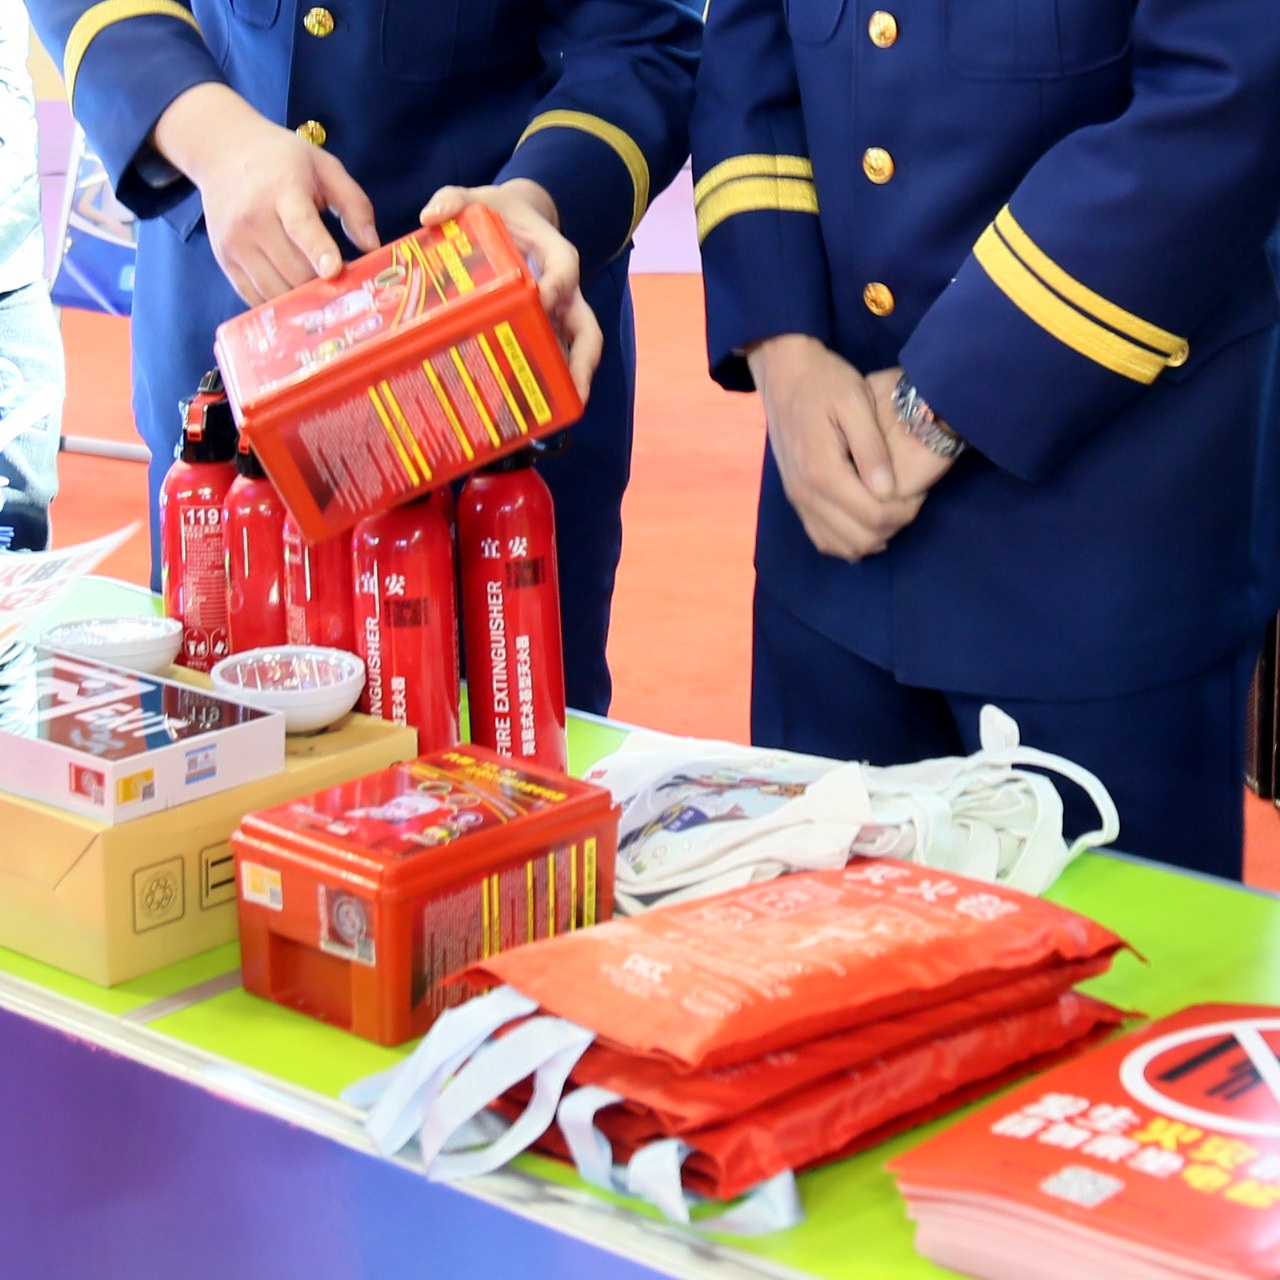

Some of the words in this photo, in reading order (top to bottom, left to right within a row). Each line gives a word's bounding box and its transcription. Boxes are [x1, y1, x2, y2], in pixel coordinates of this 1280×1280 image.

[186, 508, 219, 526] 119
[481, 535, 529, 559] 宜安
[486, 580, 511, 713] EXTINGUISHER
[496, 717, 513, 758] FIRE
